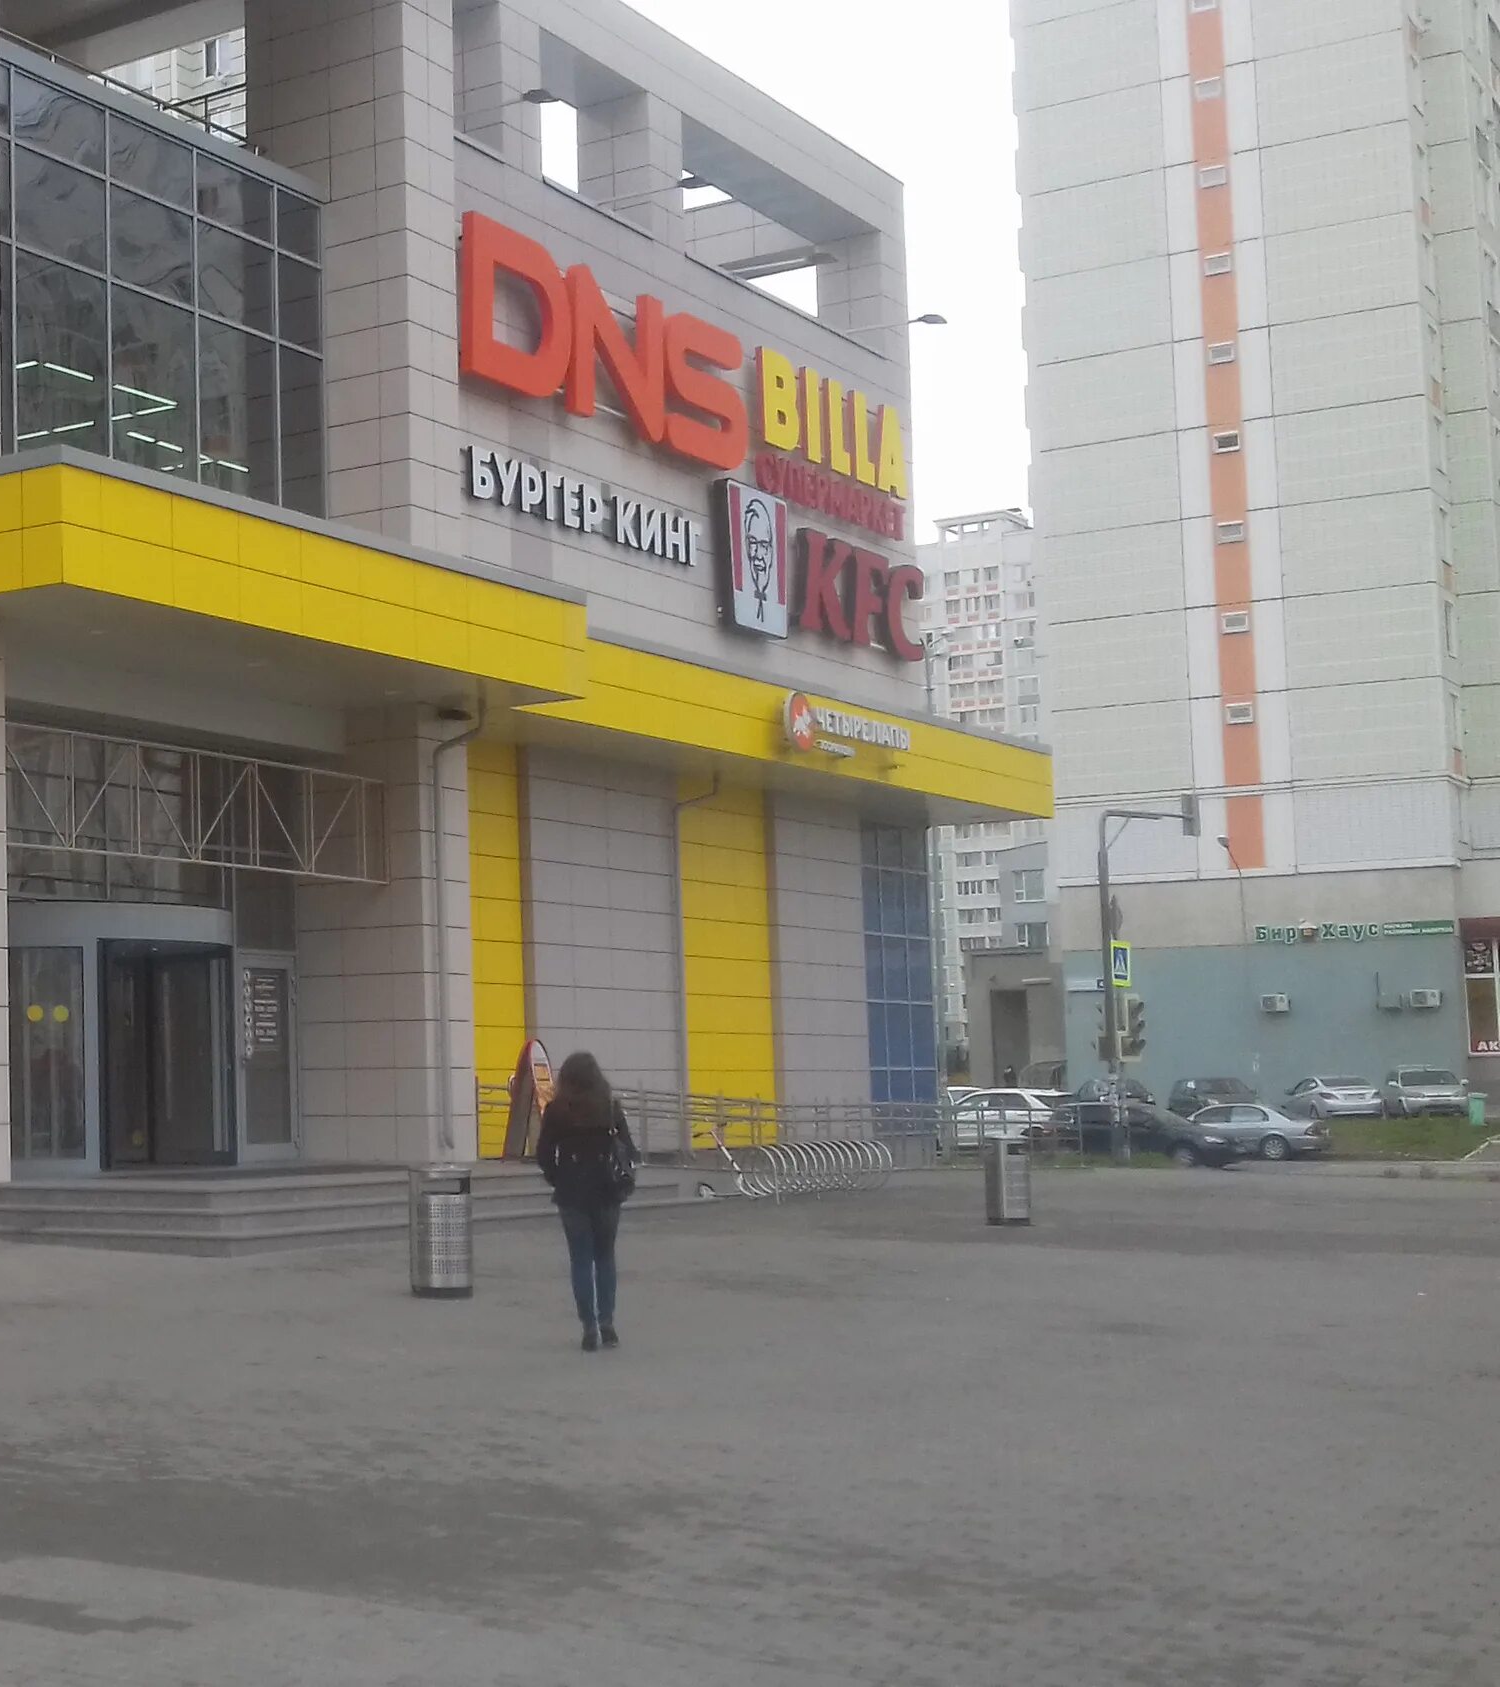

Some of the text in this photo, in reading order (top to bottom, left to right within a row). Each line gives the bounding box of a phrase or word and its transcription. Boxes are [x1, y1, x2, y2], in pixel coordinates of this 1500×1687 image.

[459, 210, 749, 471] DNS
[755, 345, 907, 499] BILLA
[468, 444, 702, 567] БУРГЕР КИНГ
[755, 452, 906, 541] СУПЕРМАРКЕТ
[797, 527, 924, 662] KFC
[1322, 922, 1379, 943] Хаус
